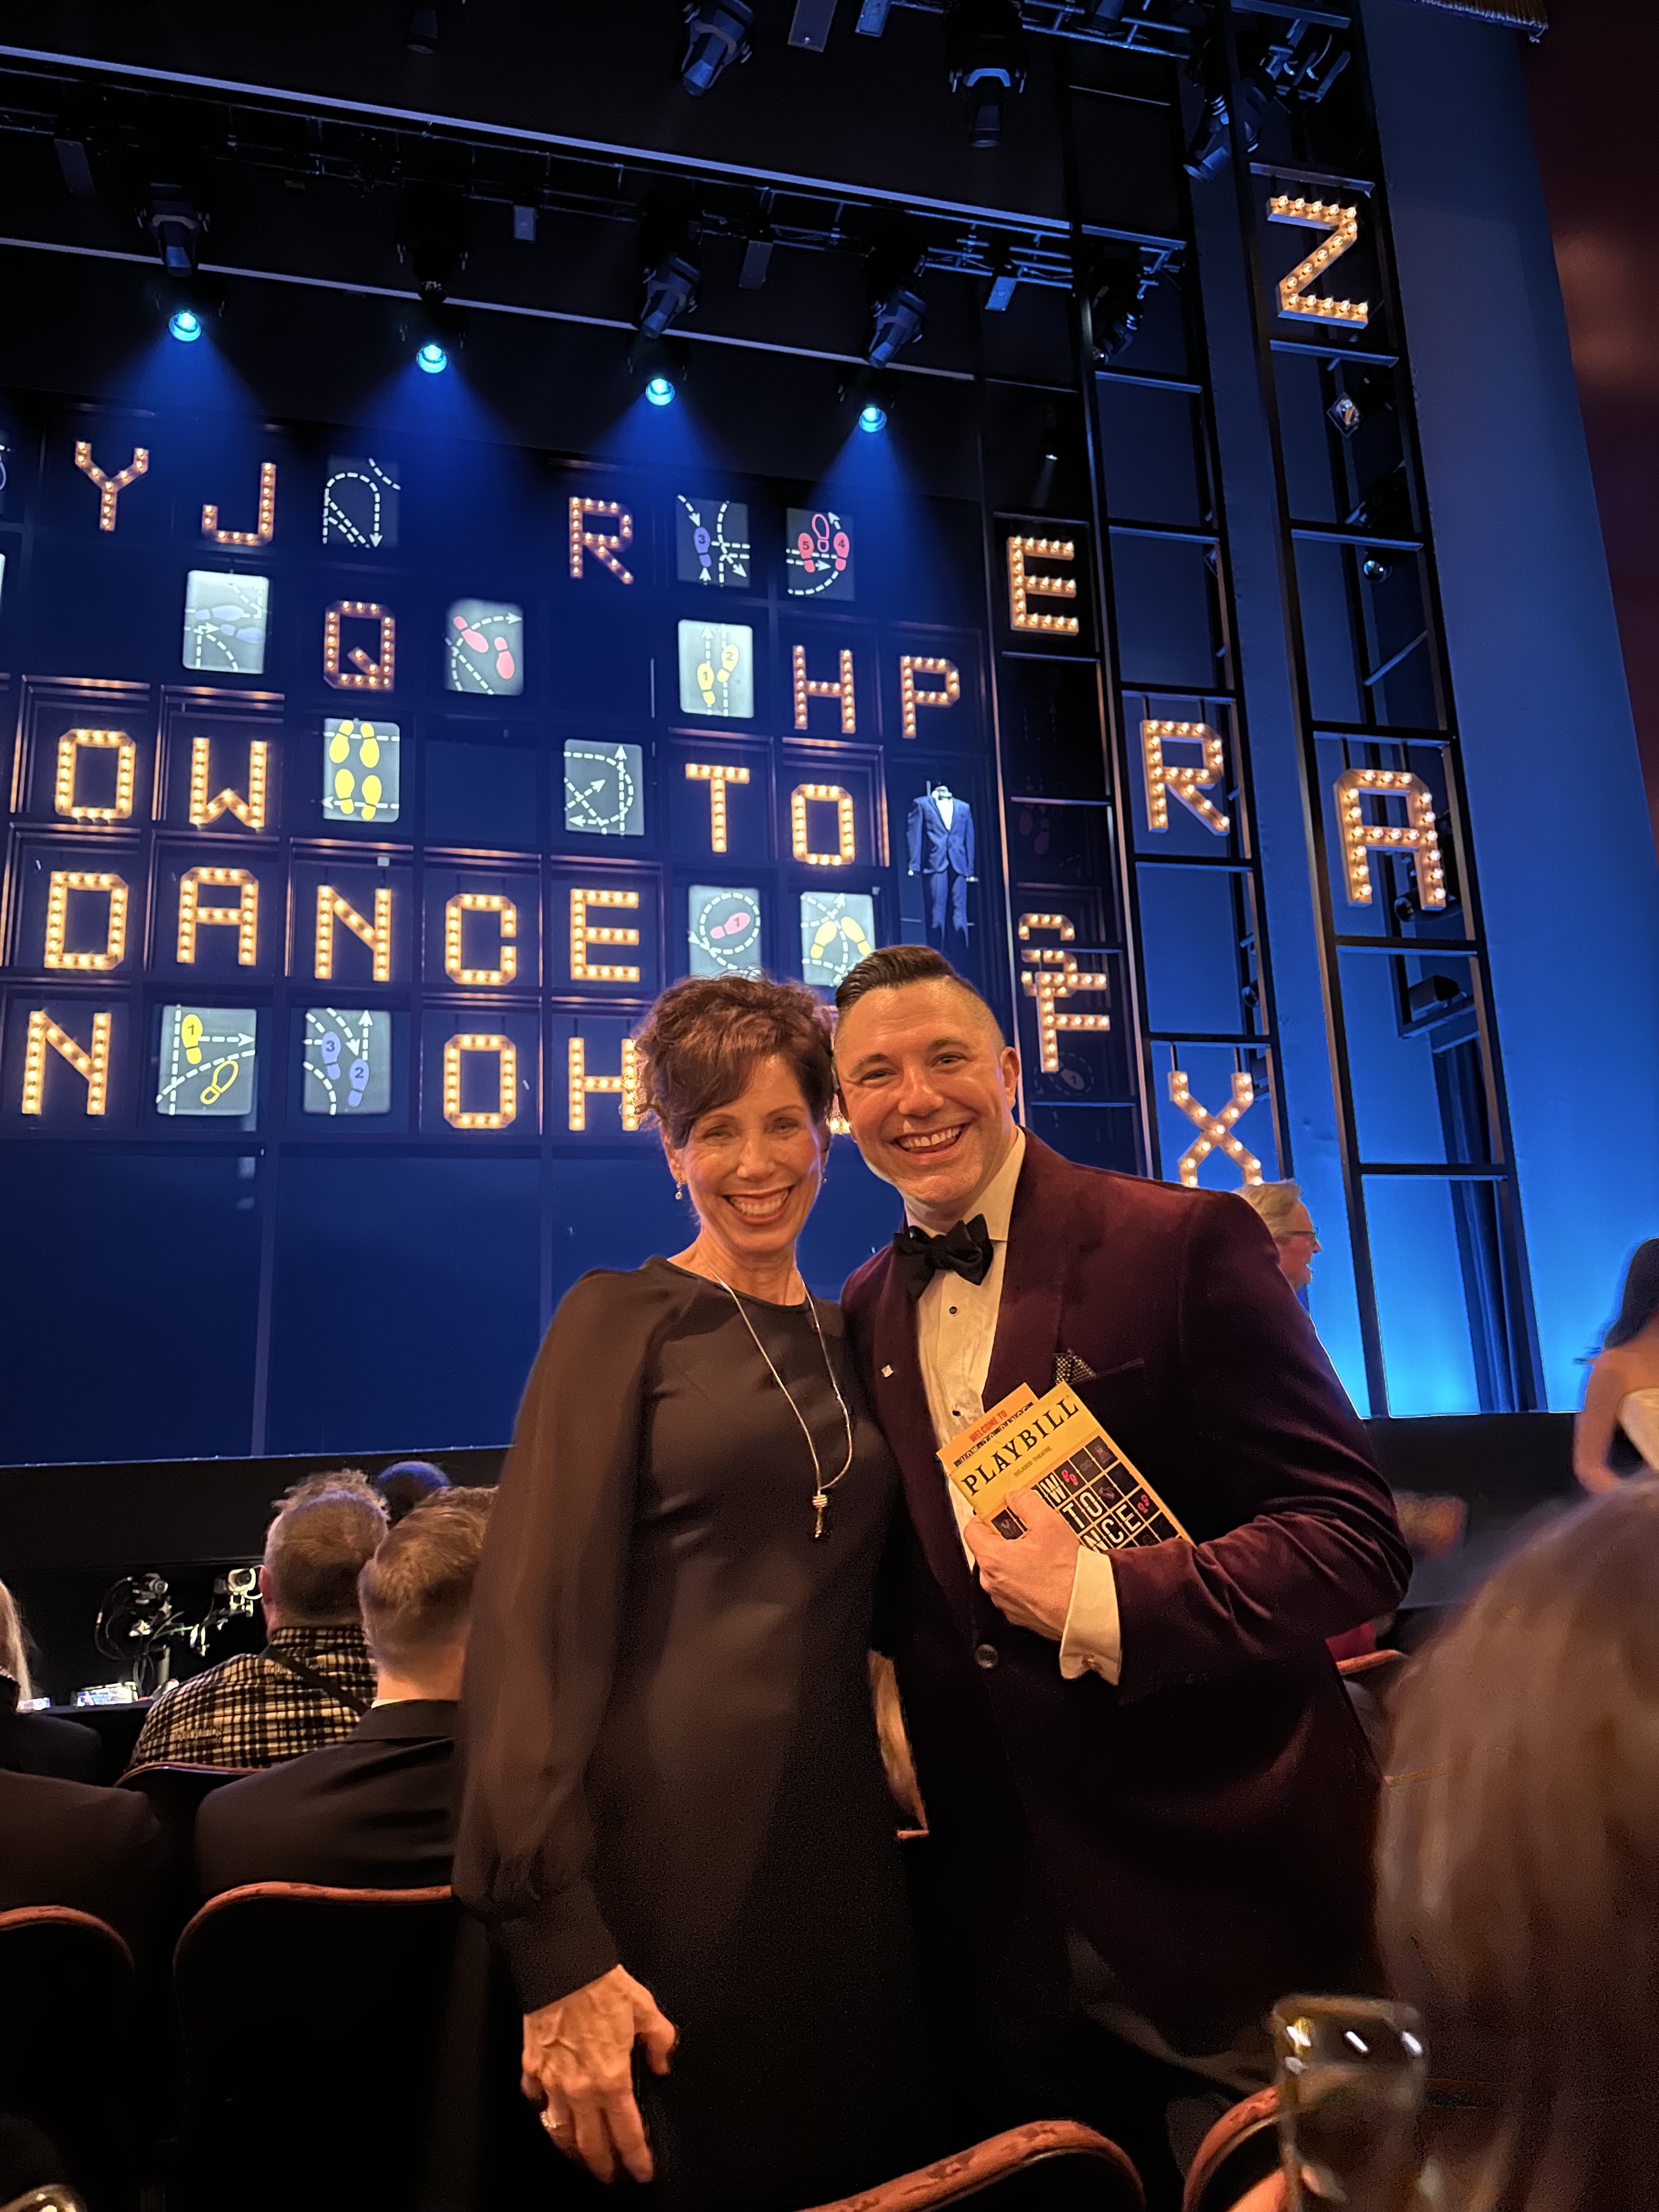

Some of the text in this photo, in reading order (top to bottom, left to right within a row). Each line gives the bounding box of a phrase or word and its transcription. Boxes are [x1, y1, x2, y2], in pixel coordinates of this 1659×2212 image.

[1267, 196, 1368, 329] Z
[75, 442, 149, 531] Y
[202, 462, 276, 545] J
[569, 497, 633, 584] R
[1007, 535, 1079, 635] E
[324, 600, 395, 692] Q
[793, 645, 856, 733] H
[901, 656, 960, 738] P
[686, 763, 855, 865] TO
[1140, 720, 1230, 836] R
[1334, 769, 1447, 911] A
[44, 866, 640, 985] DANCE
[188, 1023, 195, 1035] 1
[326, 1040, 335, 1052] 3
[1035, 971, 1110, 1073] F
[355, 1066, 364, 1079] 2
[1168, 1071, 1262, 1187] X
[961, 1398, 1079, 1497] PLAYBILL
[969, 1410, 1007, 1442] WELCOME TO
[1014, 1446, 1052, 1477] BELASCO THEATRE
[1062, 1492, 1103, 1529] TO
